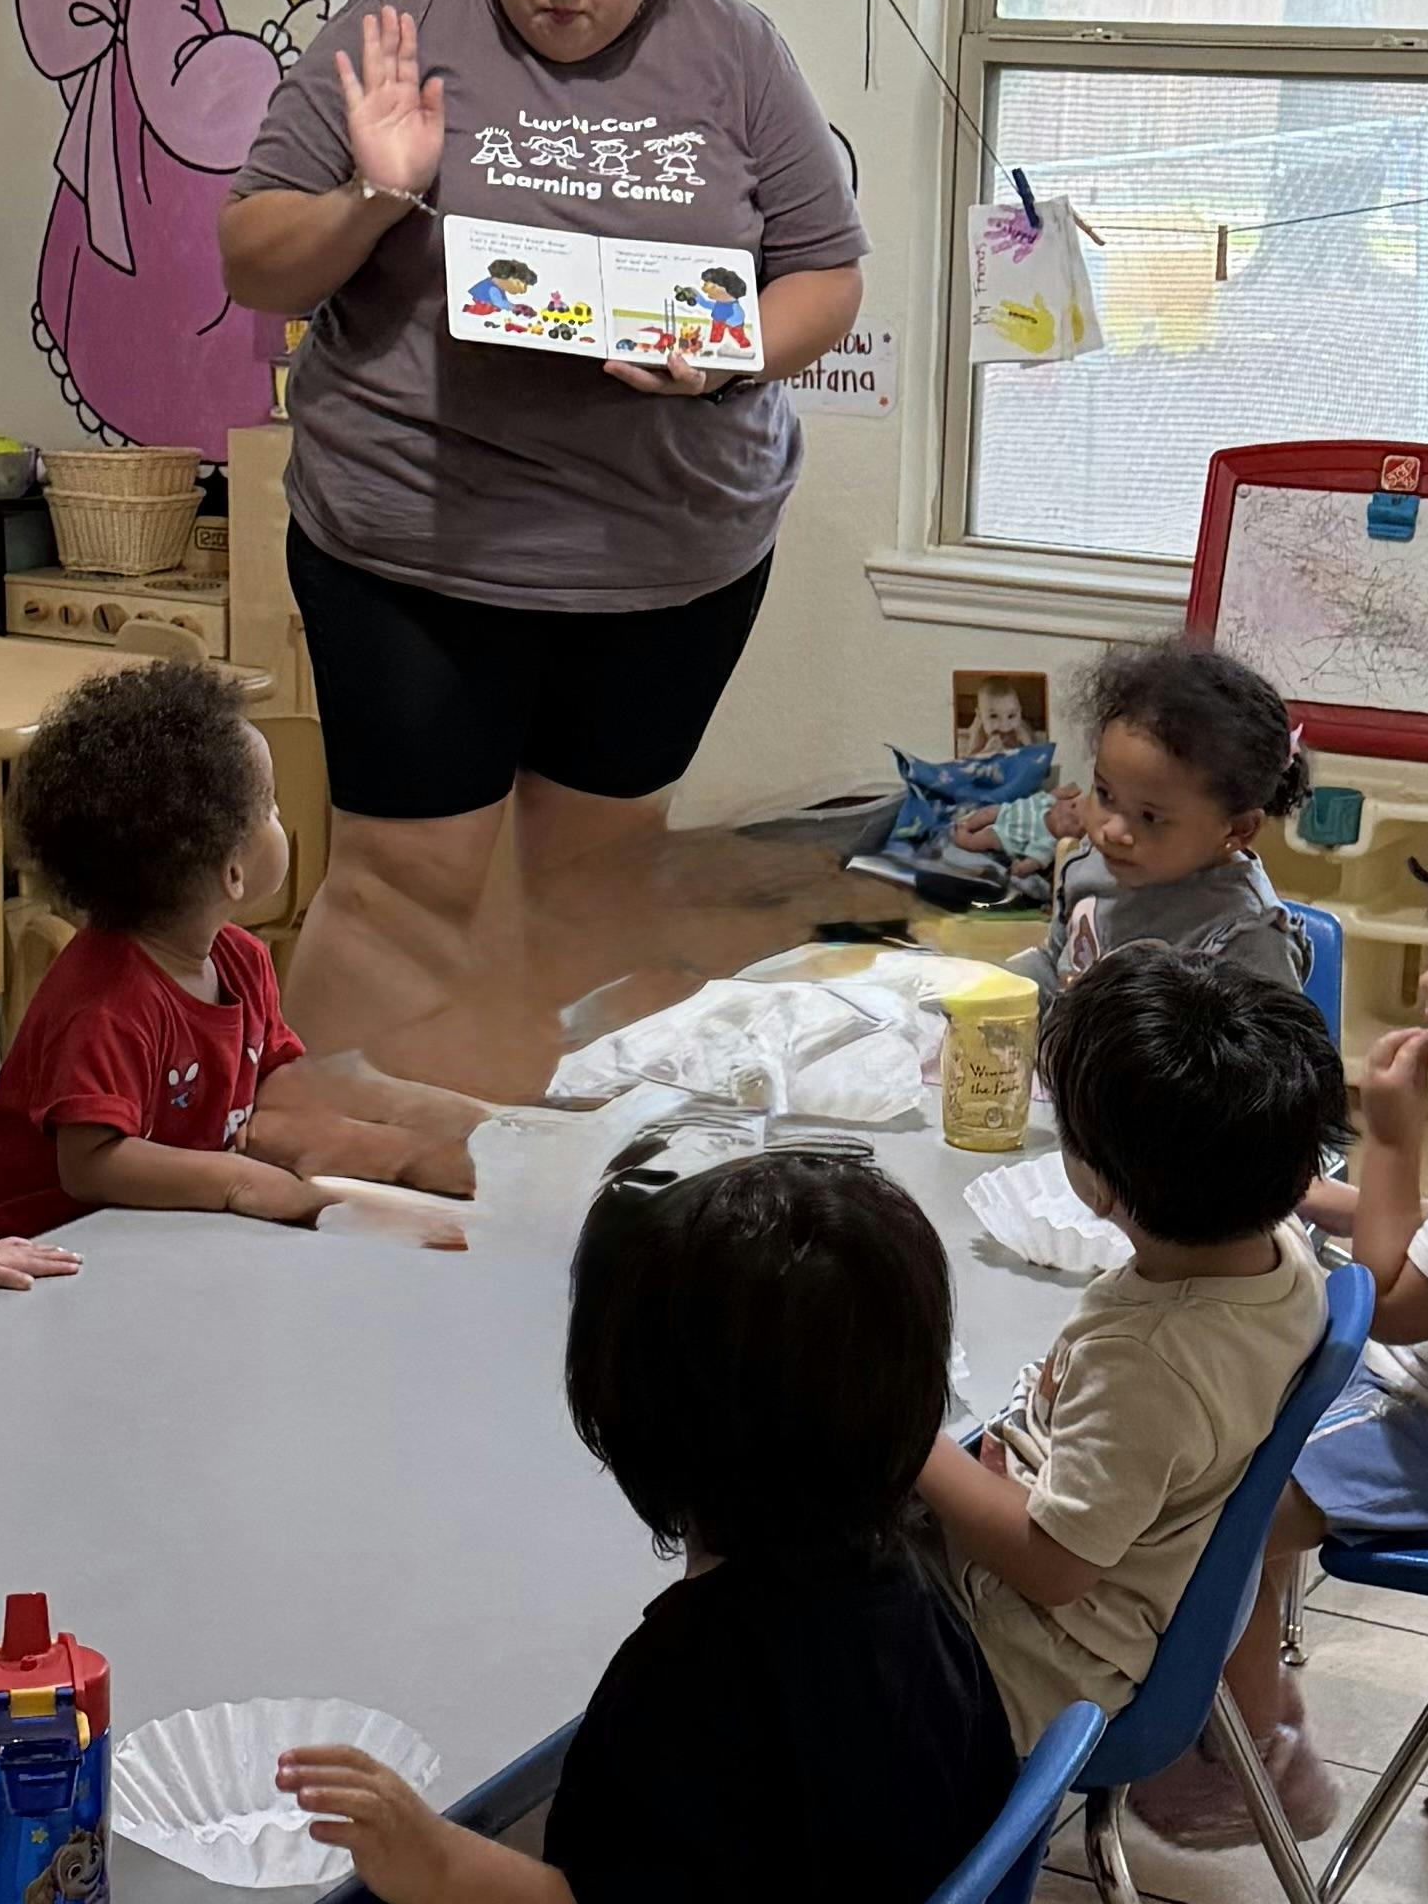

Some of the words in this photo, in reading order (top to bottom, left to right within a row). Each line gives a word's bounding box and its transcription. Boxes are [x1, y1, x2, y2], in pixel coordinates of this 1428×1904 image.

[486, 166, 603, 200] Learning
[611, 179, 696, 205] Center
[783, 359, 876, 394] entana
